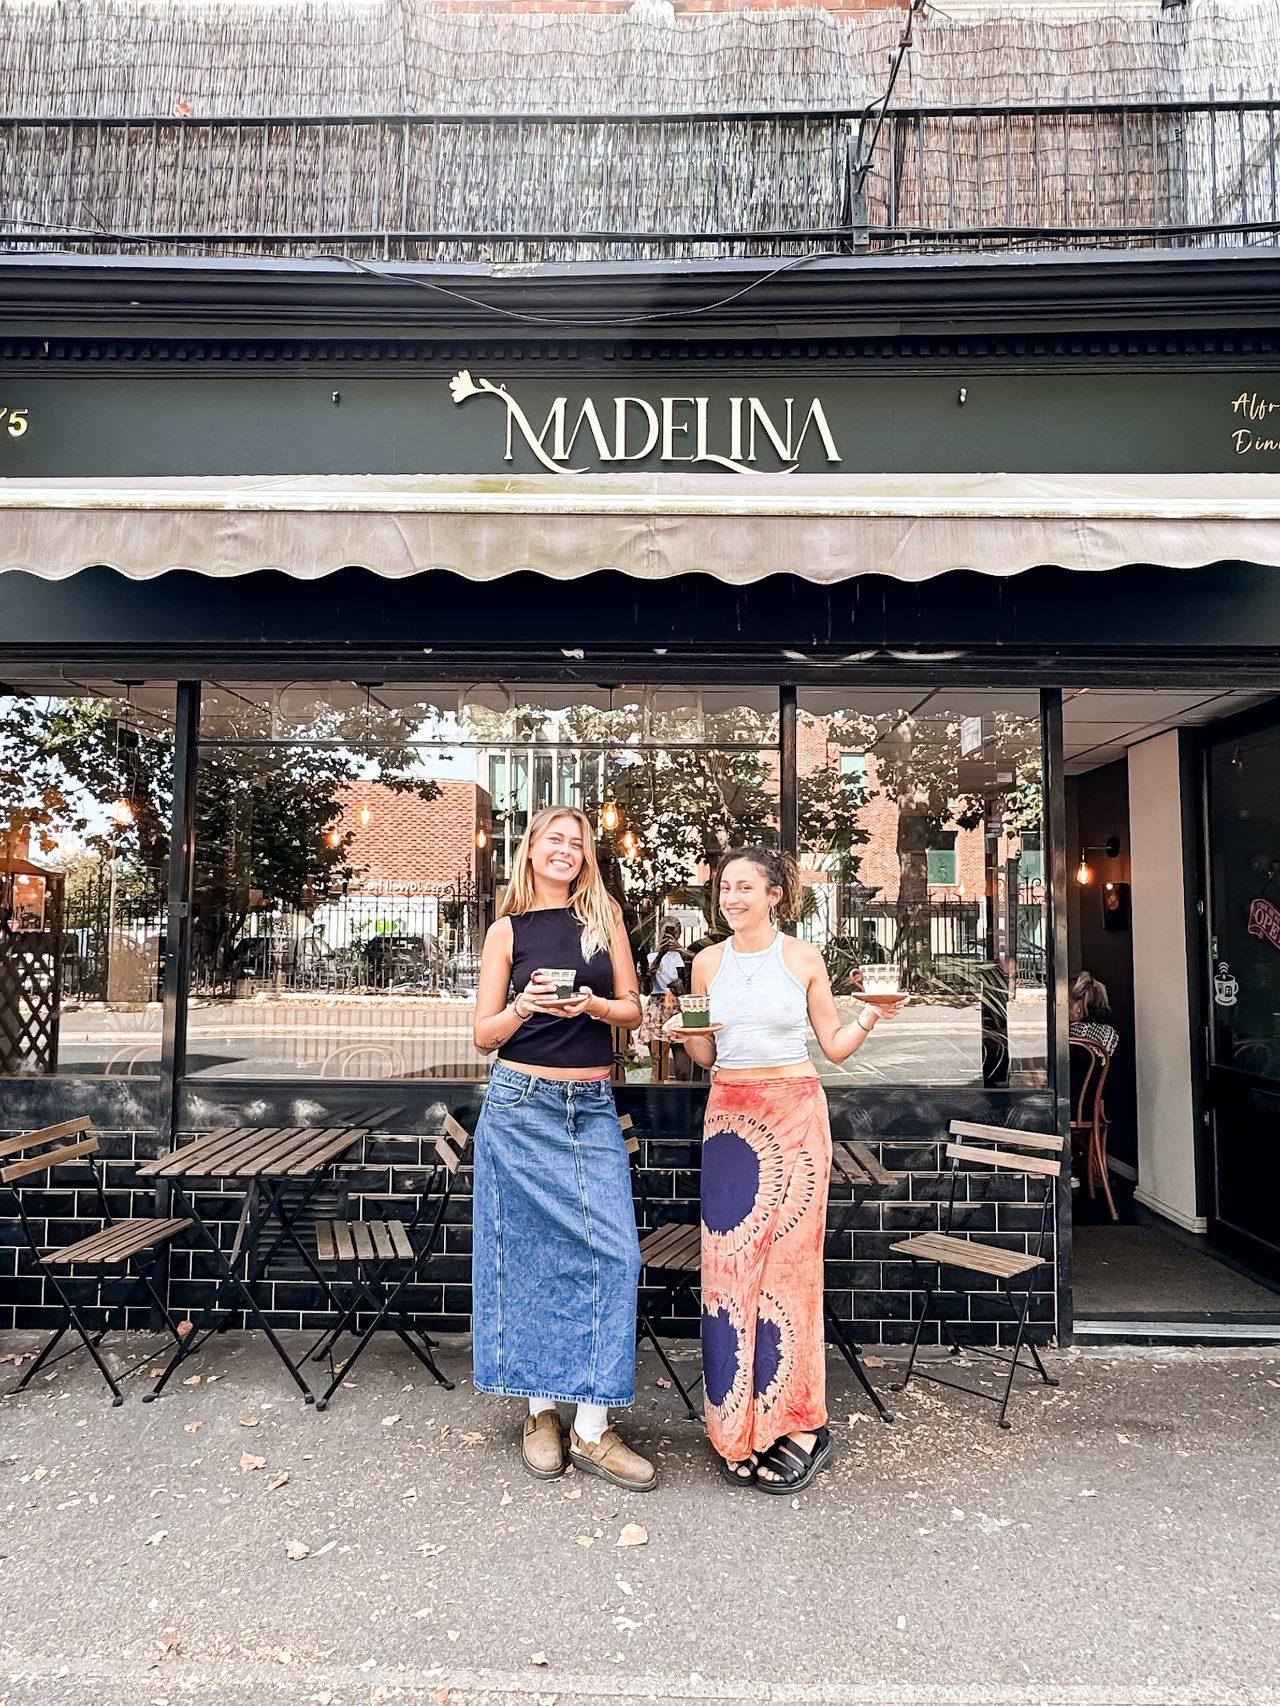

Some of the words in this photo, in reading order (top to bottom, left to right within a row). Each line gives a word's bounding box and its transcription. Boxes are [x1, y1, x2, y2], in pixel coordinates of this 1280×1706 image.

[1231, 392, 1280, 420] Alfr
[502, 397, 842, 474] MADELINA
[1231, 429, 1280, 454] Din
[1255, 908, 1280, 944] OPE
